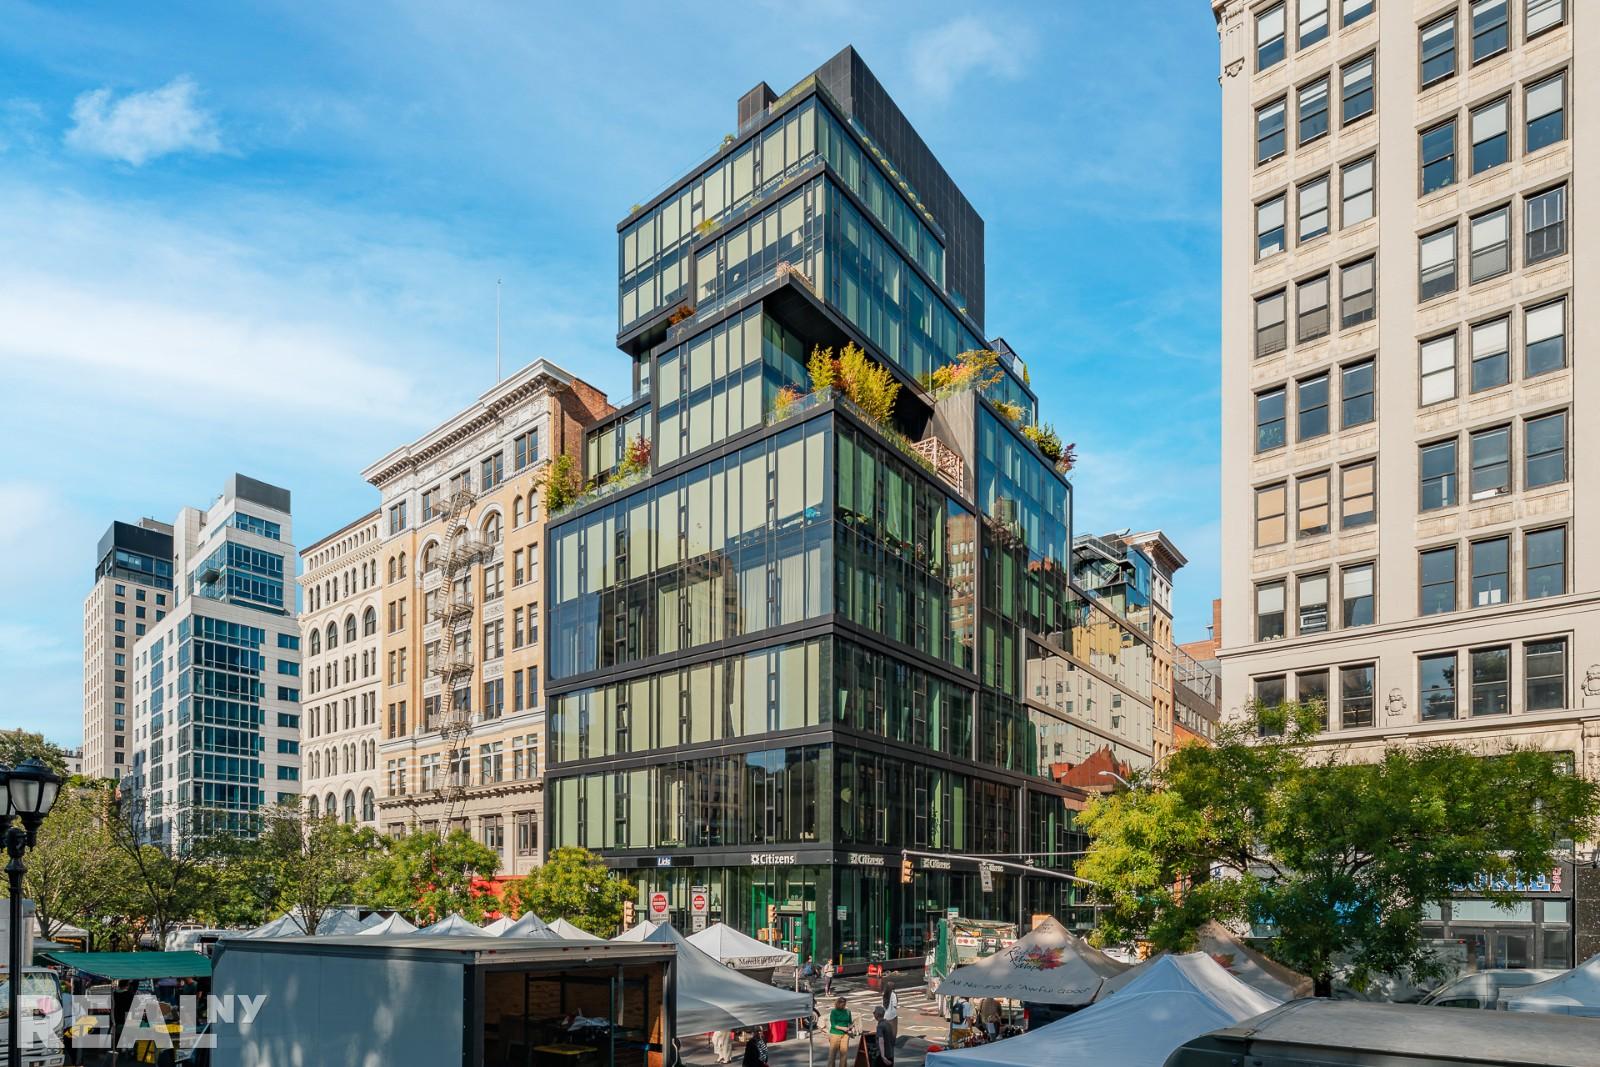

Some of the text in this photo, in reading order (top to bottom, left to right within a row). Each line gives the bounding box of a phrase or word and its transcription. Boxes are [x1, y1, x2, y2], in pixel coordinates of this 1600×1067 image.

[657, 857, 671, 866] Lids
[760, 853, 794, 865] Citizens
[858, 854, 885, 866] Citizens
[930, 859, 951, 870] Citizens
